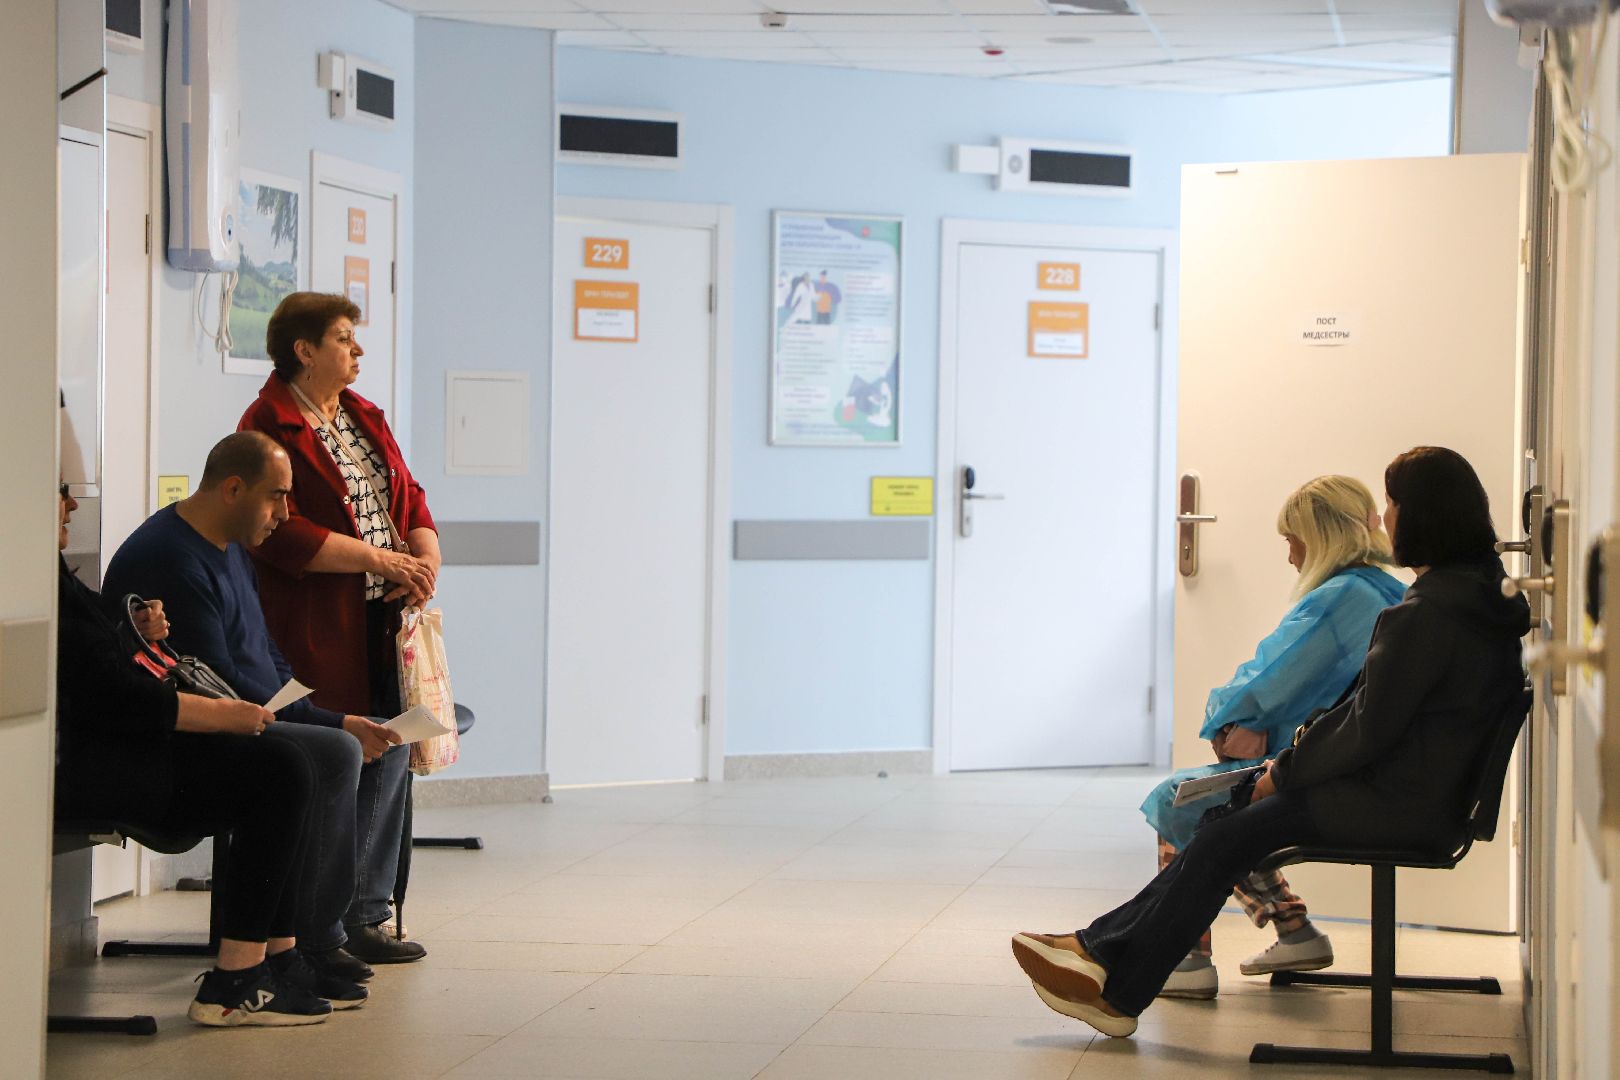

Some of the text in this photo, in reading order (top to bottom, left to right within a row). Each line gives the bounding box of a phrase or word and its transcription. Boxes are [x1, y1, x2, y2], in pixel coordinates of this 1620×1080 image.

[592, 244, 622, 263] 229
[1045, 267, 1075, 285] 228
[1316, 317, 1337, 325] ПОСТ
[1302, 331, 1350, 340] МЕДСЕСТРЫ
